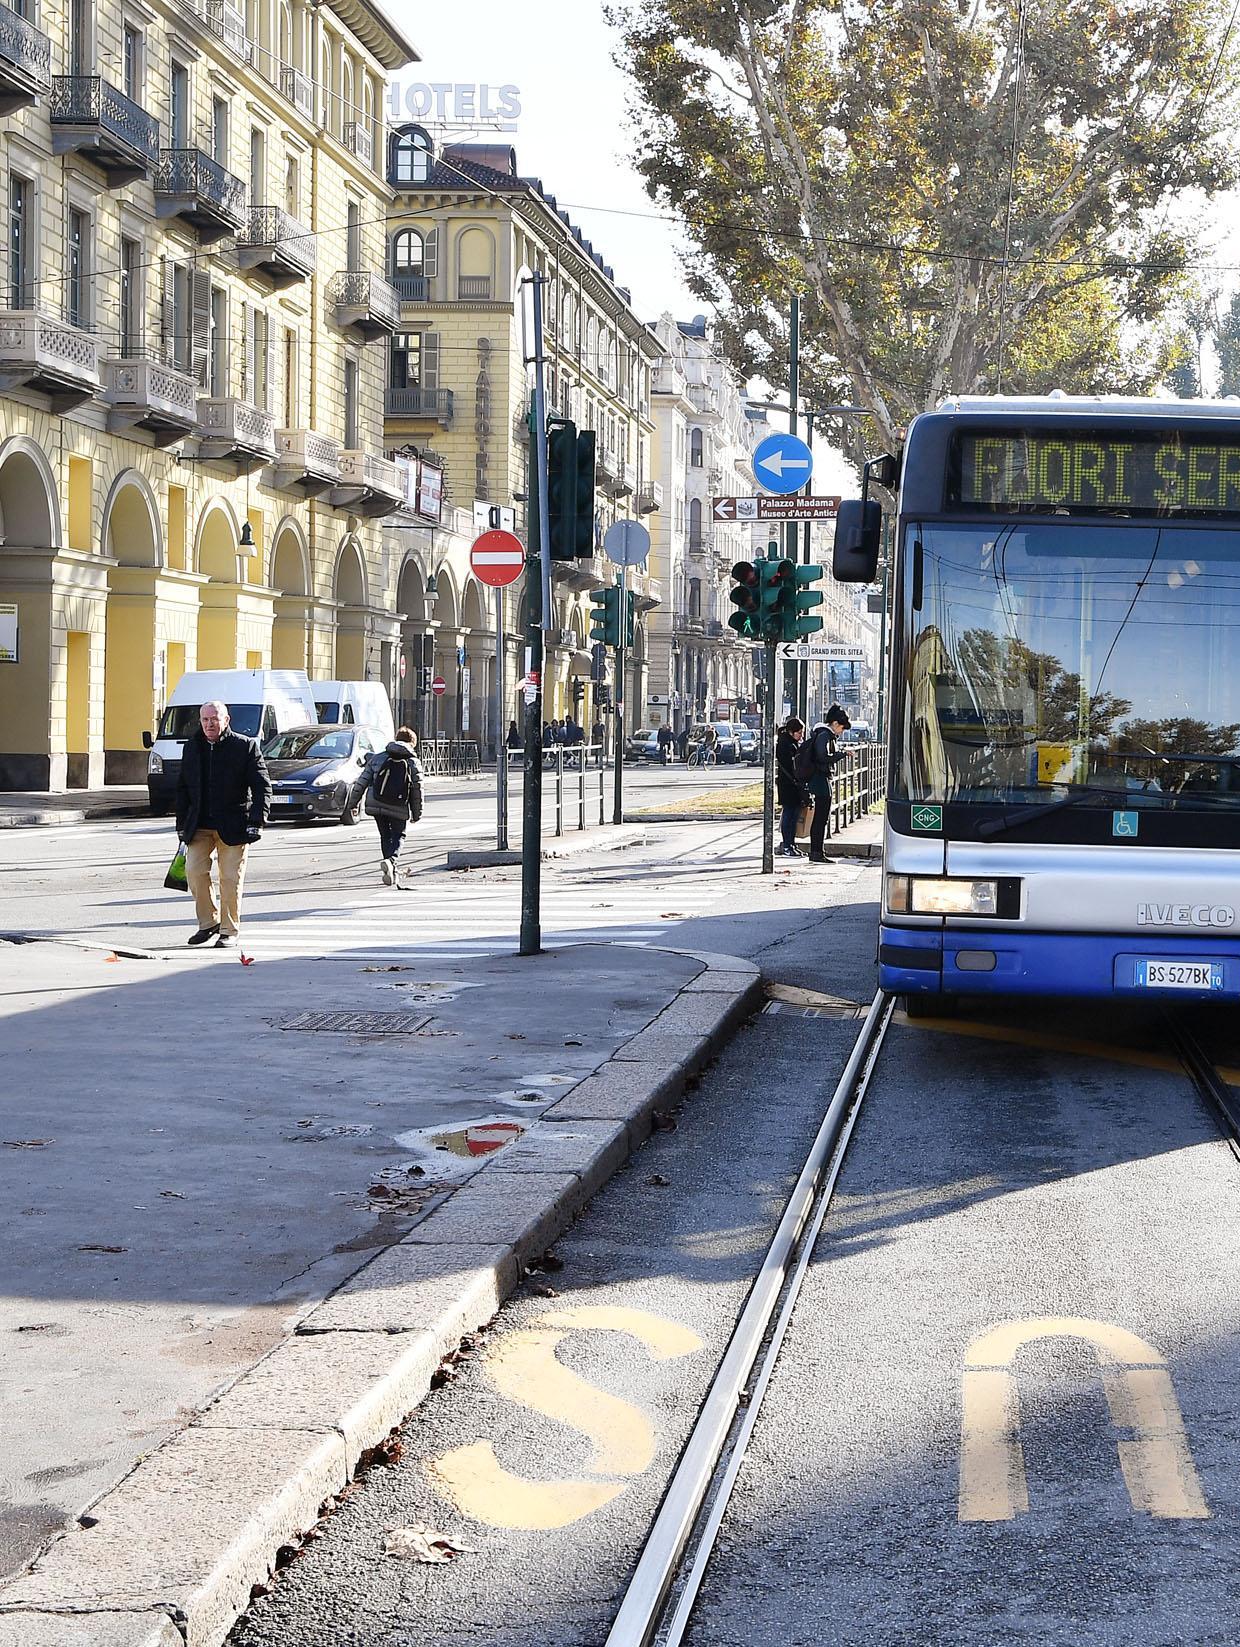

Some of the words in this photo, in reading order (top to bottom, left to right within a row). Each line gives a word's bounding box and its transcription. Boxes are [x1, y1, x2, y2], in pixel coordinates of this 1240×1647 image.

[973, 437, 1134, 504] FUORI
[760, 499, 794, 508] Palazzo
[796, 498, 834, 508] Madama
[760, 510, 786, 518] Museo
[788, 509, 812, 517] d'Arte
[813, 509, 838, 517] Antica
[811, 647, 829, 655] GRAND
[830, 647, 847, 656] HOTEL
[848, 648, 863, 656] SITEA
[918, 814, 935, 822] CNG
[1136, 902, 1236, 928] IVECO
